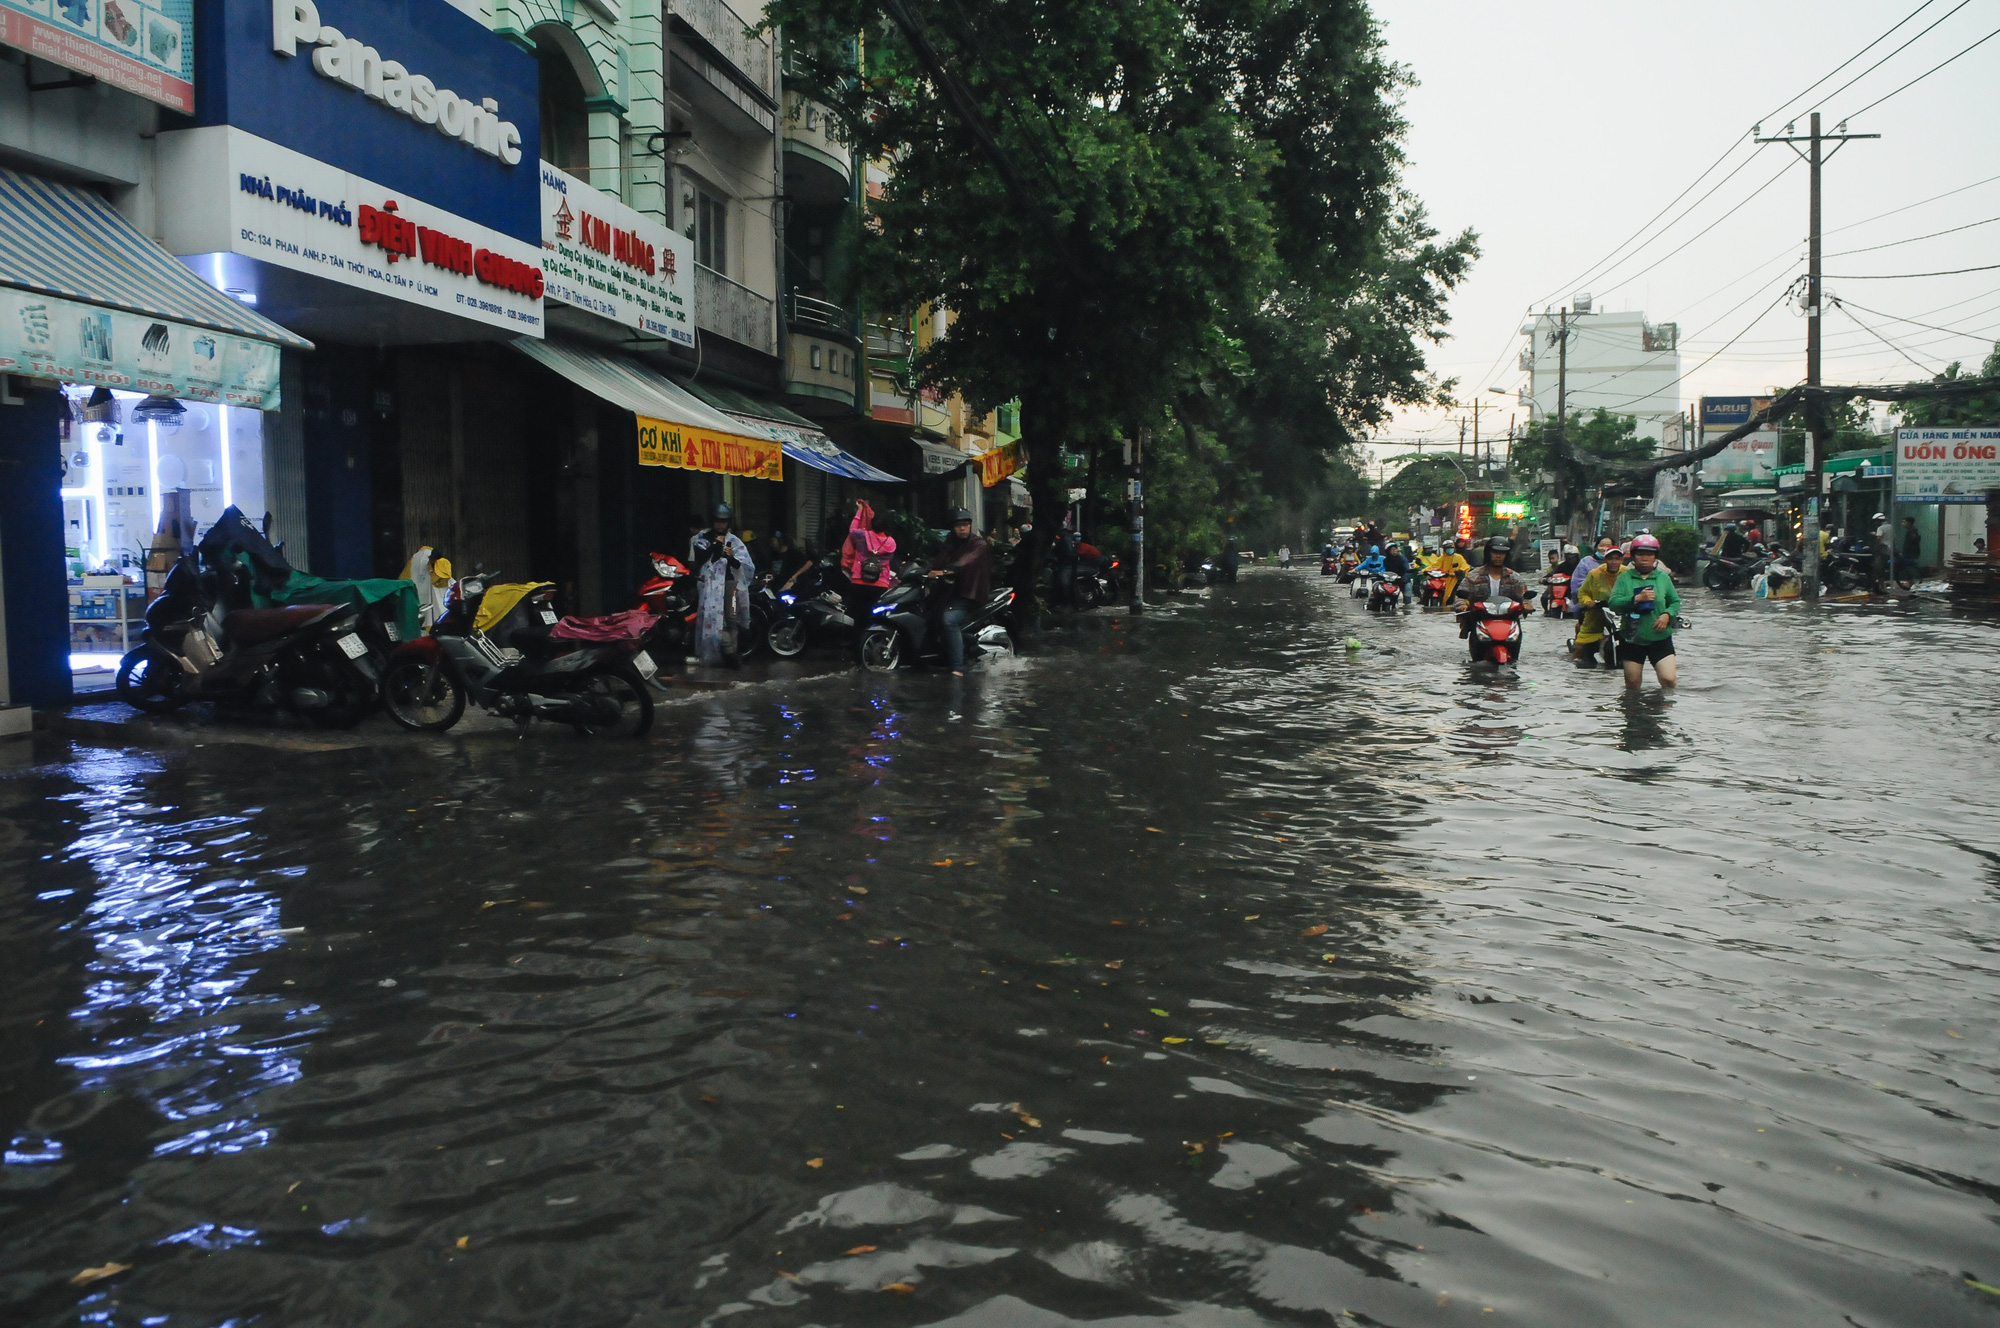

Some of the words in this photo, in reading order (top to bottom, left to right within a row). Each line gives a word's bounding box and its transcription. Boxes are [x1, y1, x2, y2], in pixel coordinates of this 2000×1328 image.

[272, 0, 522, 165] Panasonic
[542, 170, 567, 195] HÀNG
[240, 173, 274, 201] NHÀ
[276, 185, 317, 216] PHÂN
[319, 200, 352, 227] PHỐI
[553, 196, 575, 240] 金
[580, 210, 611, 256] KIM
[258, 234, 272, 247] 134
[275, 239, 299, 255] PHAN
[424, 286, 438, 296] HCM
[358, 200, 416, 264] ĐIỆN
[417, 226, 473, 278] VINH
[474, 248, 544, 300] QUANG
[30, 360, 74, 378] TÂN
[1706, 404, 1748, 413] LARUE
[640, 426, 657, 449] CƠ
[661, 428, 682, 453] KHÍ
[1900, 429, 1919, 440] CỬA
[1904, 440, 1946, 460] UỐN
[1953, 440, 1996, 460] ỐNG
[700, 438, 721, 469] KIM
